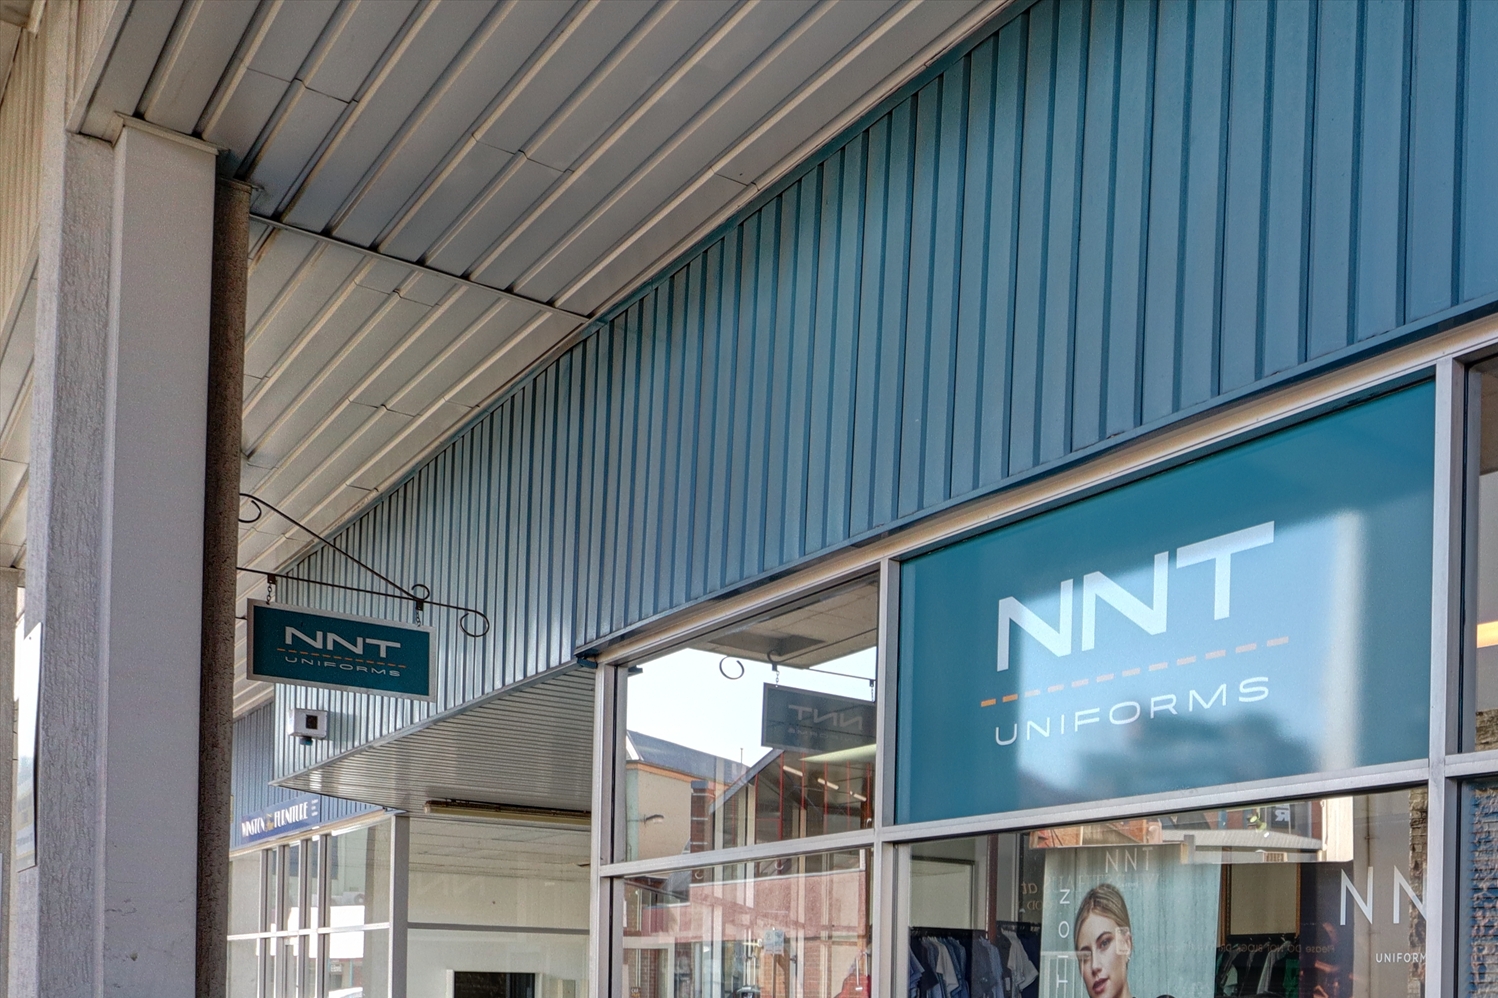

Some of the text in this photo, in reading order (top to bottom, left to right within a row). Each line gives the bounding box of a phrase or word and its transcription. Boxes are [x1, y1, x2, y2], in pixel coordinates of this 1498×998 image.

[997, 520, 1275, 672] NNT
[285, 626, 401, 658] NNT
[284, 656, 401, 677] UNIFORMS
[995, 676, 1269, 746] UNIFORMS
[1105, 847, 1153, 873] NNT
